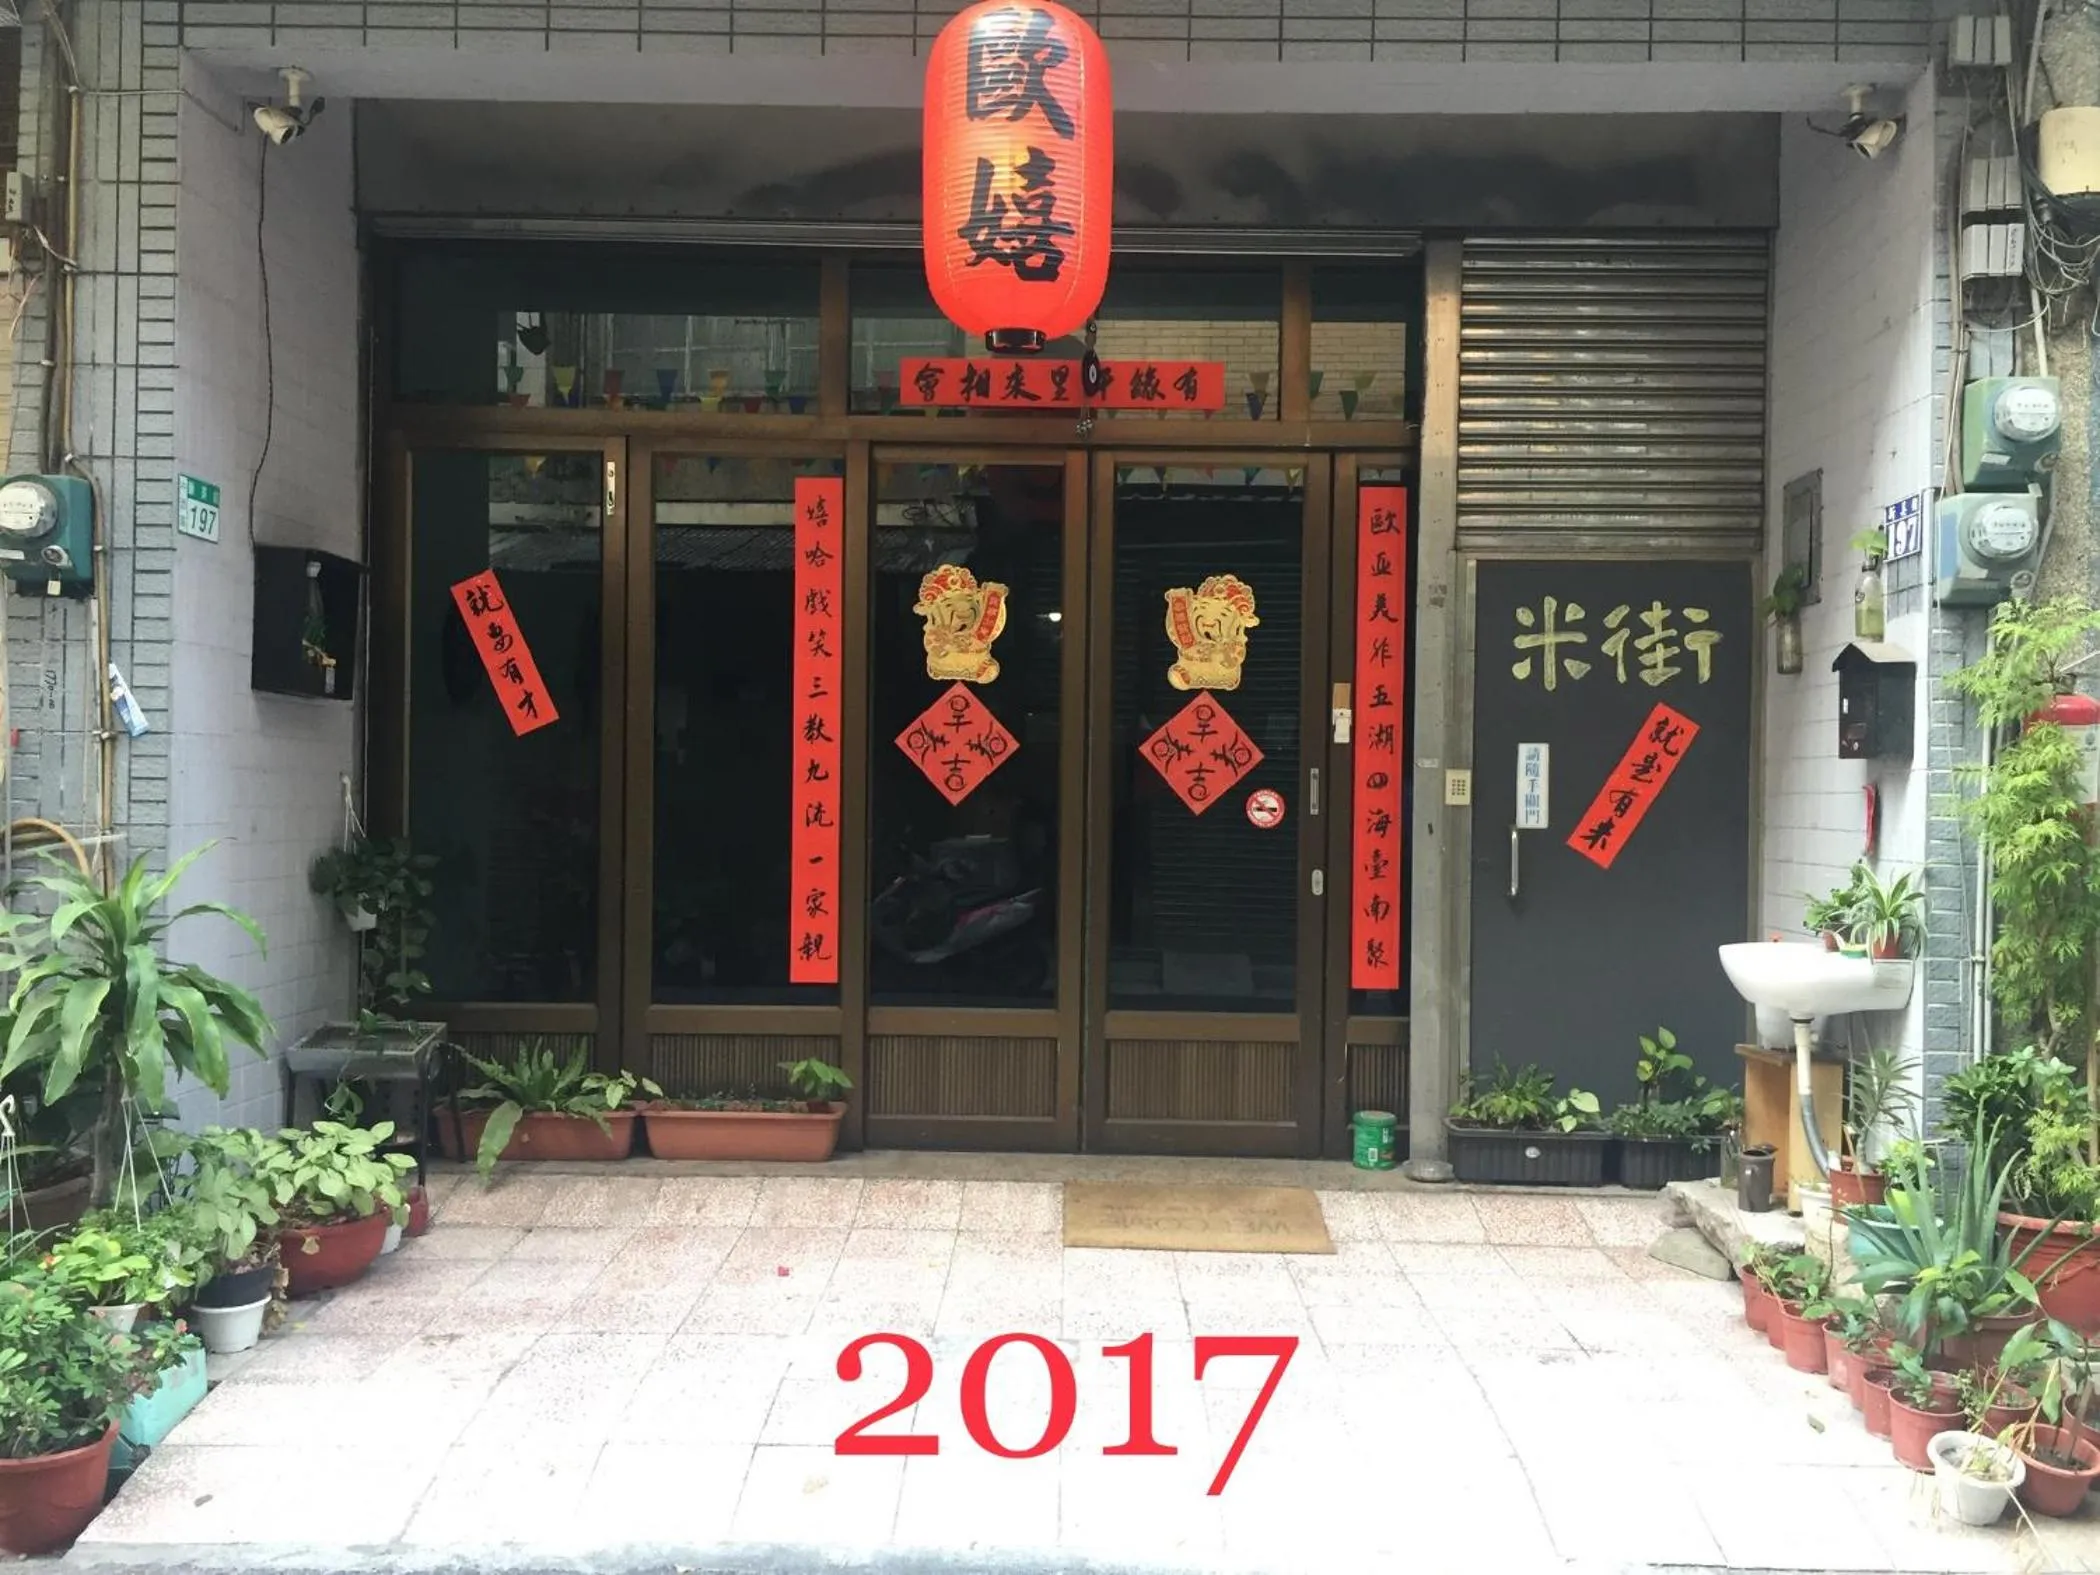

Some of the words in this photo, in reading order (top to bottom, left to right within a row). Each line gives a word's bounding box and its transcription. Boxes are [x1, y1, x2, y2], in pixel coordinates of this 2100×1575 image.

[957, 7, 1075, 282] 歐嬉
[191, 506, 216, 535] 197
[1887, 516, 1918, 559] 197
[1511, 596, 1724, 691] 米街
